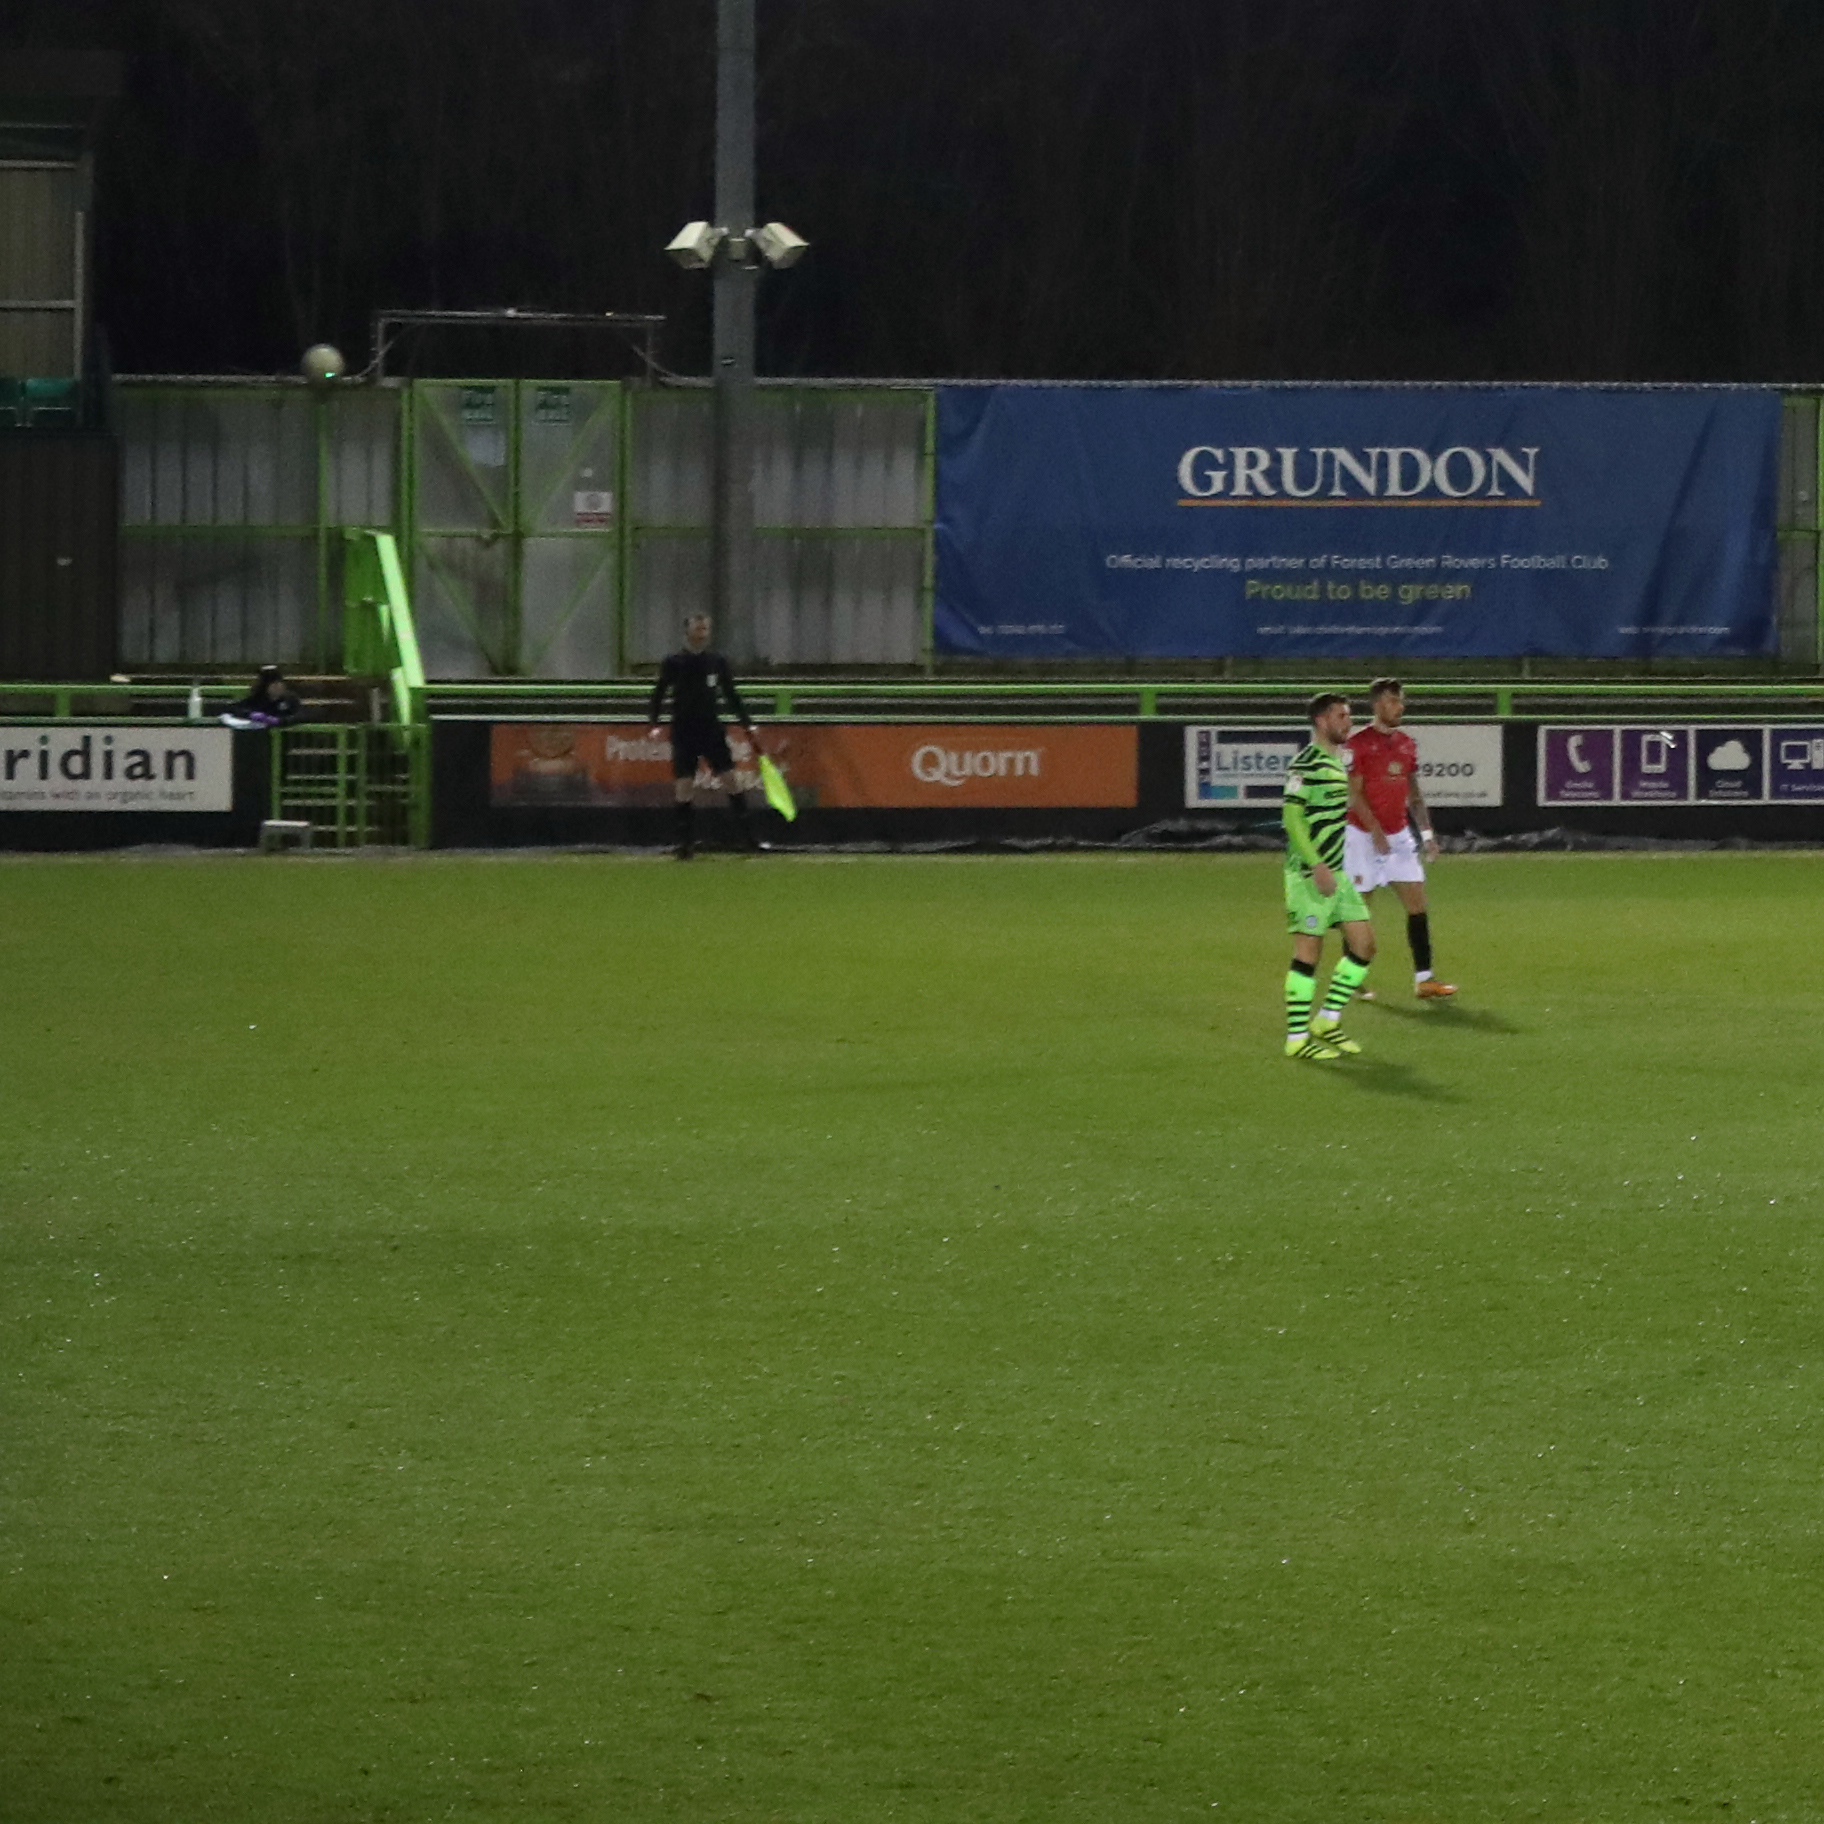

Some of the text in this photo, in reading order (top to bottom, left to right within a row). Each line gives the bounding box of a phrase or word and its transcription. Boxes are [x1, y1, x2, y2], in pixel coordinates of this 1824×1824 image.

[1177, 447, 1540, 497] GRUNDON
[1166, 555, 1241, 572] recycling
[1245, 556, 1306, 572] partner
[1309, 555, 1327, 569] of
[1331, 555, 1381, 569] Forest
[1387, 555, 1436, 569] Green
[1441, 555, 1497, 569] Rovers
[1502, 555, 1566, 569] Football
[1572, 555, 1609, 569] Club
[1247, 579, 1472, 605] Proud to be green
[5, 735, 196, 780] ridian
[911, 745, 1041, 787] Quorn
[1215, 749, 1293, 771] Lister
[1416, 763, 1474, 777] 9200
